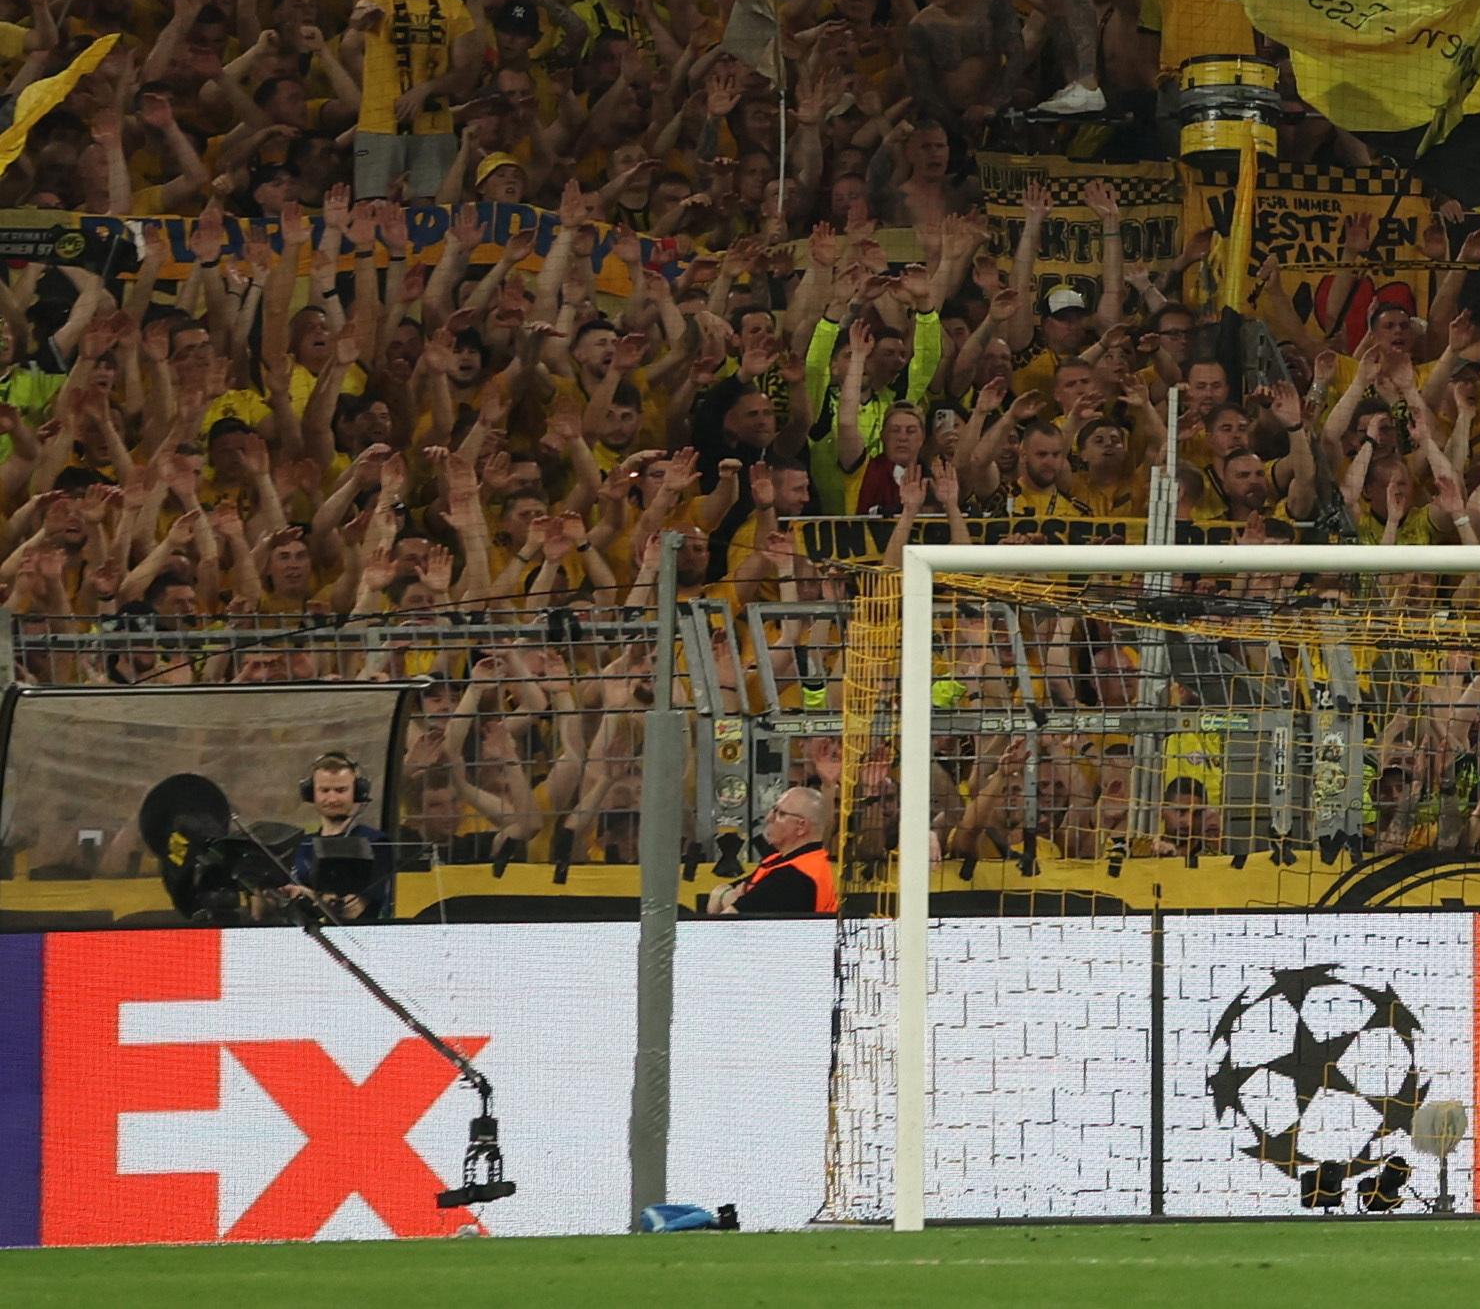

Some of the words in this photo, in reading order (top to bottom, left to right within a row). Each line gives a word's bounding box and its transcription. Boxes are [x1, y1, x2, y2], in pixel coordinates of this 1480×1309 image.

[1206, 189, 1418, 246] WESTFEN
[1257, 197, 1291, 214] FÜR
[1292, 197, 1343, 214] IMMER
